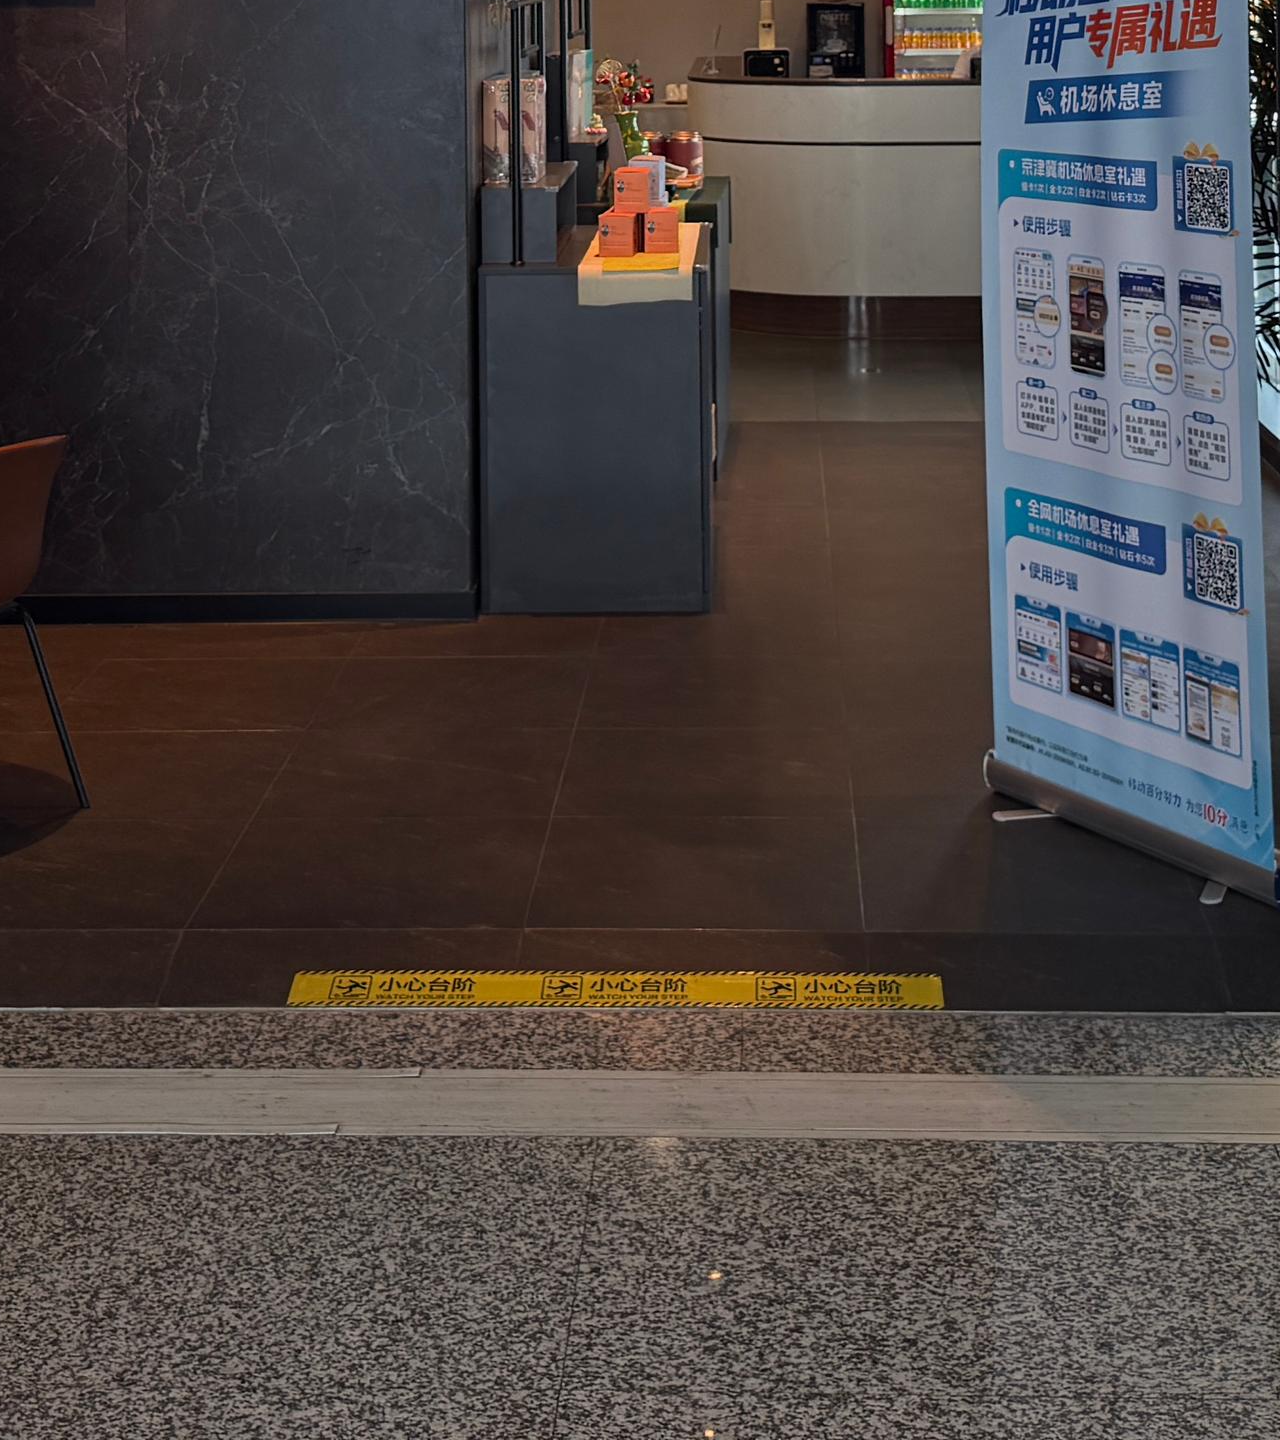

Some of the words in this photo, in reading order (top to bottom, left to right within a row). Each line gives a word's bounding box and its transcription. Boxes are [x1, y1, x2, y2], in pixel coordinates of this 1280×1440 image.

[1059, 80, 1163, 114] 机场休息室
[1021, 158, 1146, 187] 京津冀机场休息室礼遇
[1022, 215, 1072, 237] 使用步骤
[1027, 500, 1140, 547] 全网机场休息室礼遇
[1028, 562, 1079, 592] 使用步骤
[379, 976, 476, 992] 小心台阶
[590, 977, 688, 992] 小心台阶
[804, 979, 902, 994] 小心台阶
